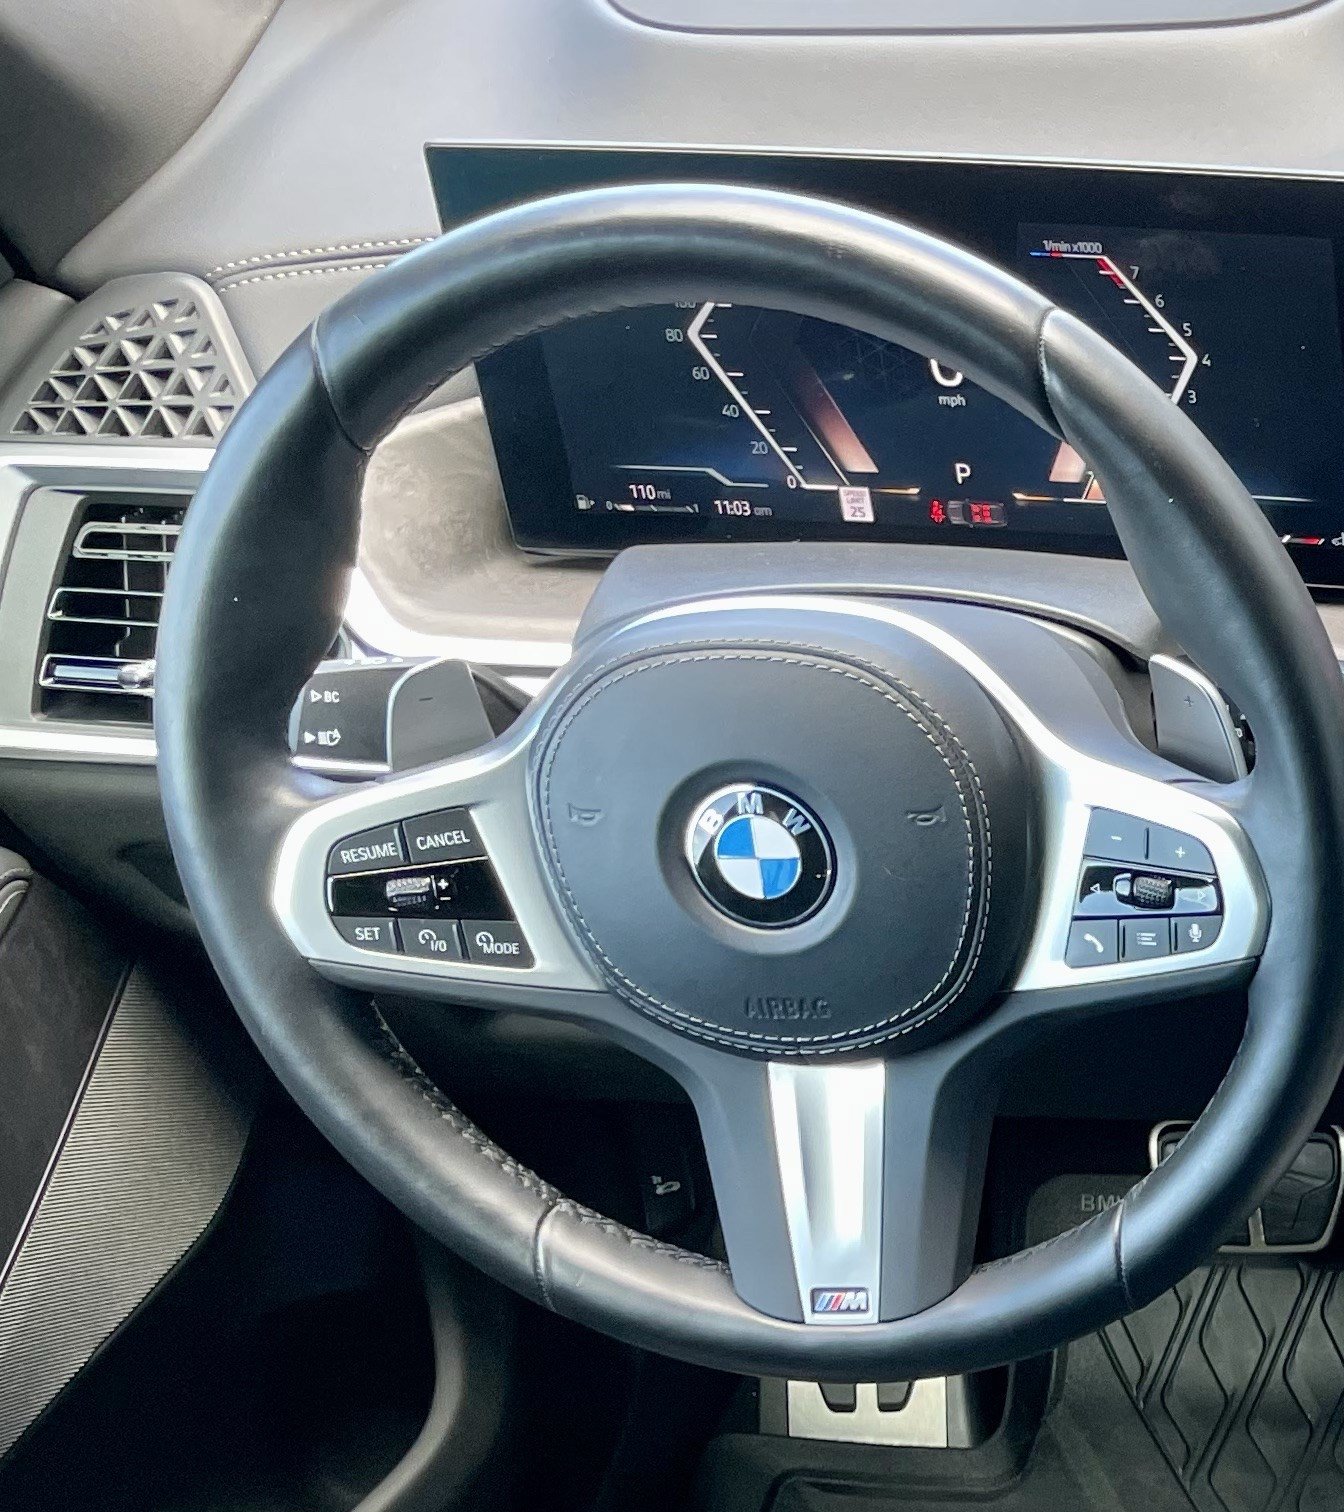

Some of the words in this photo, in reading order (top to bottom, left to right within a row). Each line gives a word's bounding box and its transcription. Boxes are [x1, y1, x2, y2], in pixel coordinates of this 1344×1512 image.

[1072, 242, 1103, 253] x1000
[1129, 265, 1140, 280] 7
[1154, 293, 1165, 308] 6
[665, 328, 684, 343] 80
[1182, 322, 1193, 337] 5
[1201, 353, 1212, 367] 4
[692, 366, 710, 380] 60
[938, 394, 967, 408] mph
[1187, 390, 1197, 404] 3
[721, 404, 740, 418] 40
[751, 441, 769, 455] 20
[955, 462, 971, 485] P
[786, 475, 797, 489] 0
[628, 484, 656, 500] 110
[714, 500, 751, 517] 11:03
[850, 505, 867, 518] 25
[697, 793, 812, 837] BMW
[416, 829, 471, 851] CANCEL
[340, 841, 398, 864] RESUME
[355, 927, 381, 942] SET
[482, 942, 520, 955] MODE
